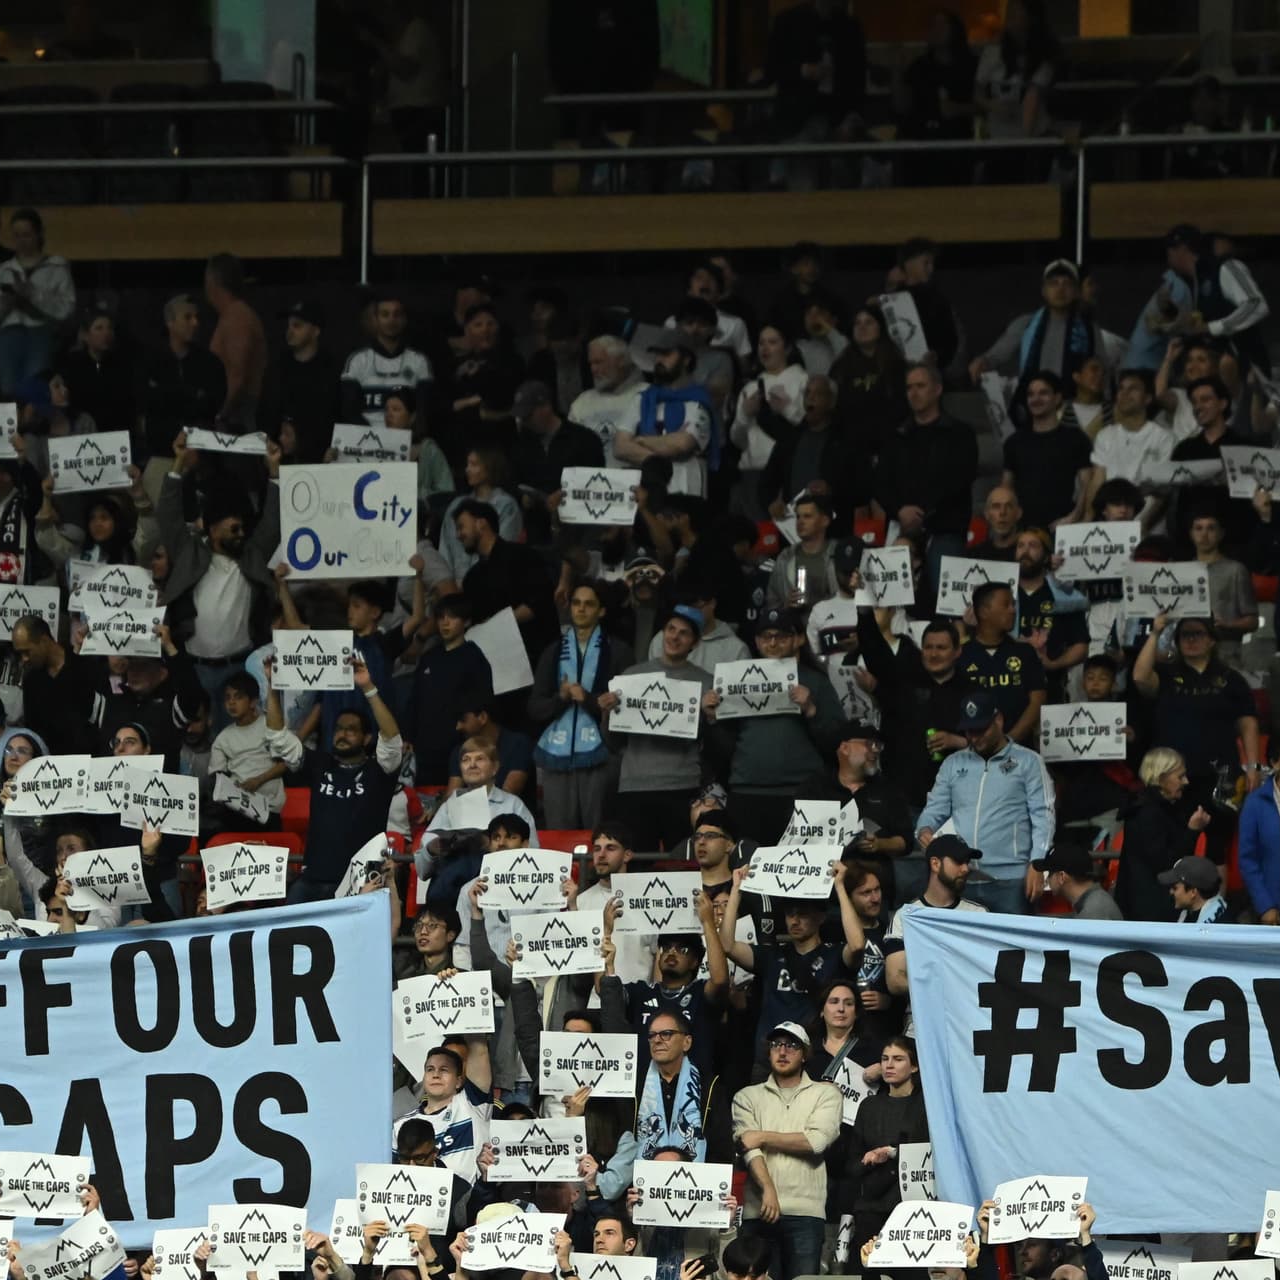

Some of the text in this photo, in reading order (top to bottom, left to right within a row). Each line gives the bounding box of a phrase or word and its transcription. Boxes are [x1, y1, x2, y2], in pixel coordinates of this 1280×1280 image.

[353, 470, 412, 528] City
[287, 527, 348, 571] Our
[282, 654, 301, 665] SAVE
[316, 654, 337, 666] CAPS
[493, 872, 515, 884] SAVE
[530, 872, 554, 884] CAPS
[110, 925, 340, 1054] OUR
[556, 1057, 578, 1070] SAVE
[594, 1058, 619, 1071] CAPS
[223, 1231, 245, 1243] SAVE
[262, 1231, 287, 1243] CAPS
